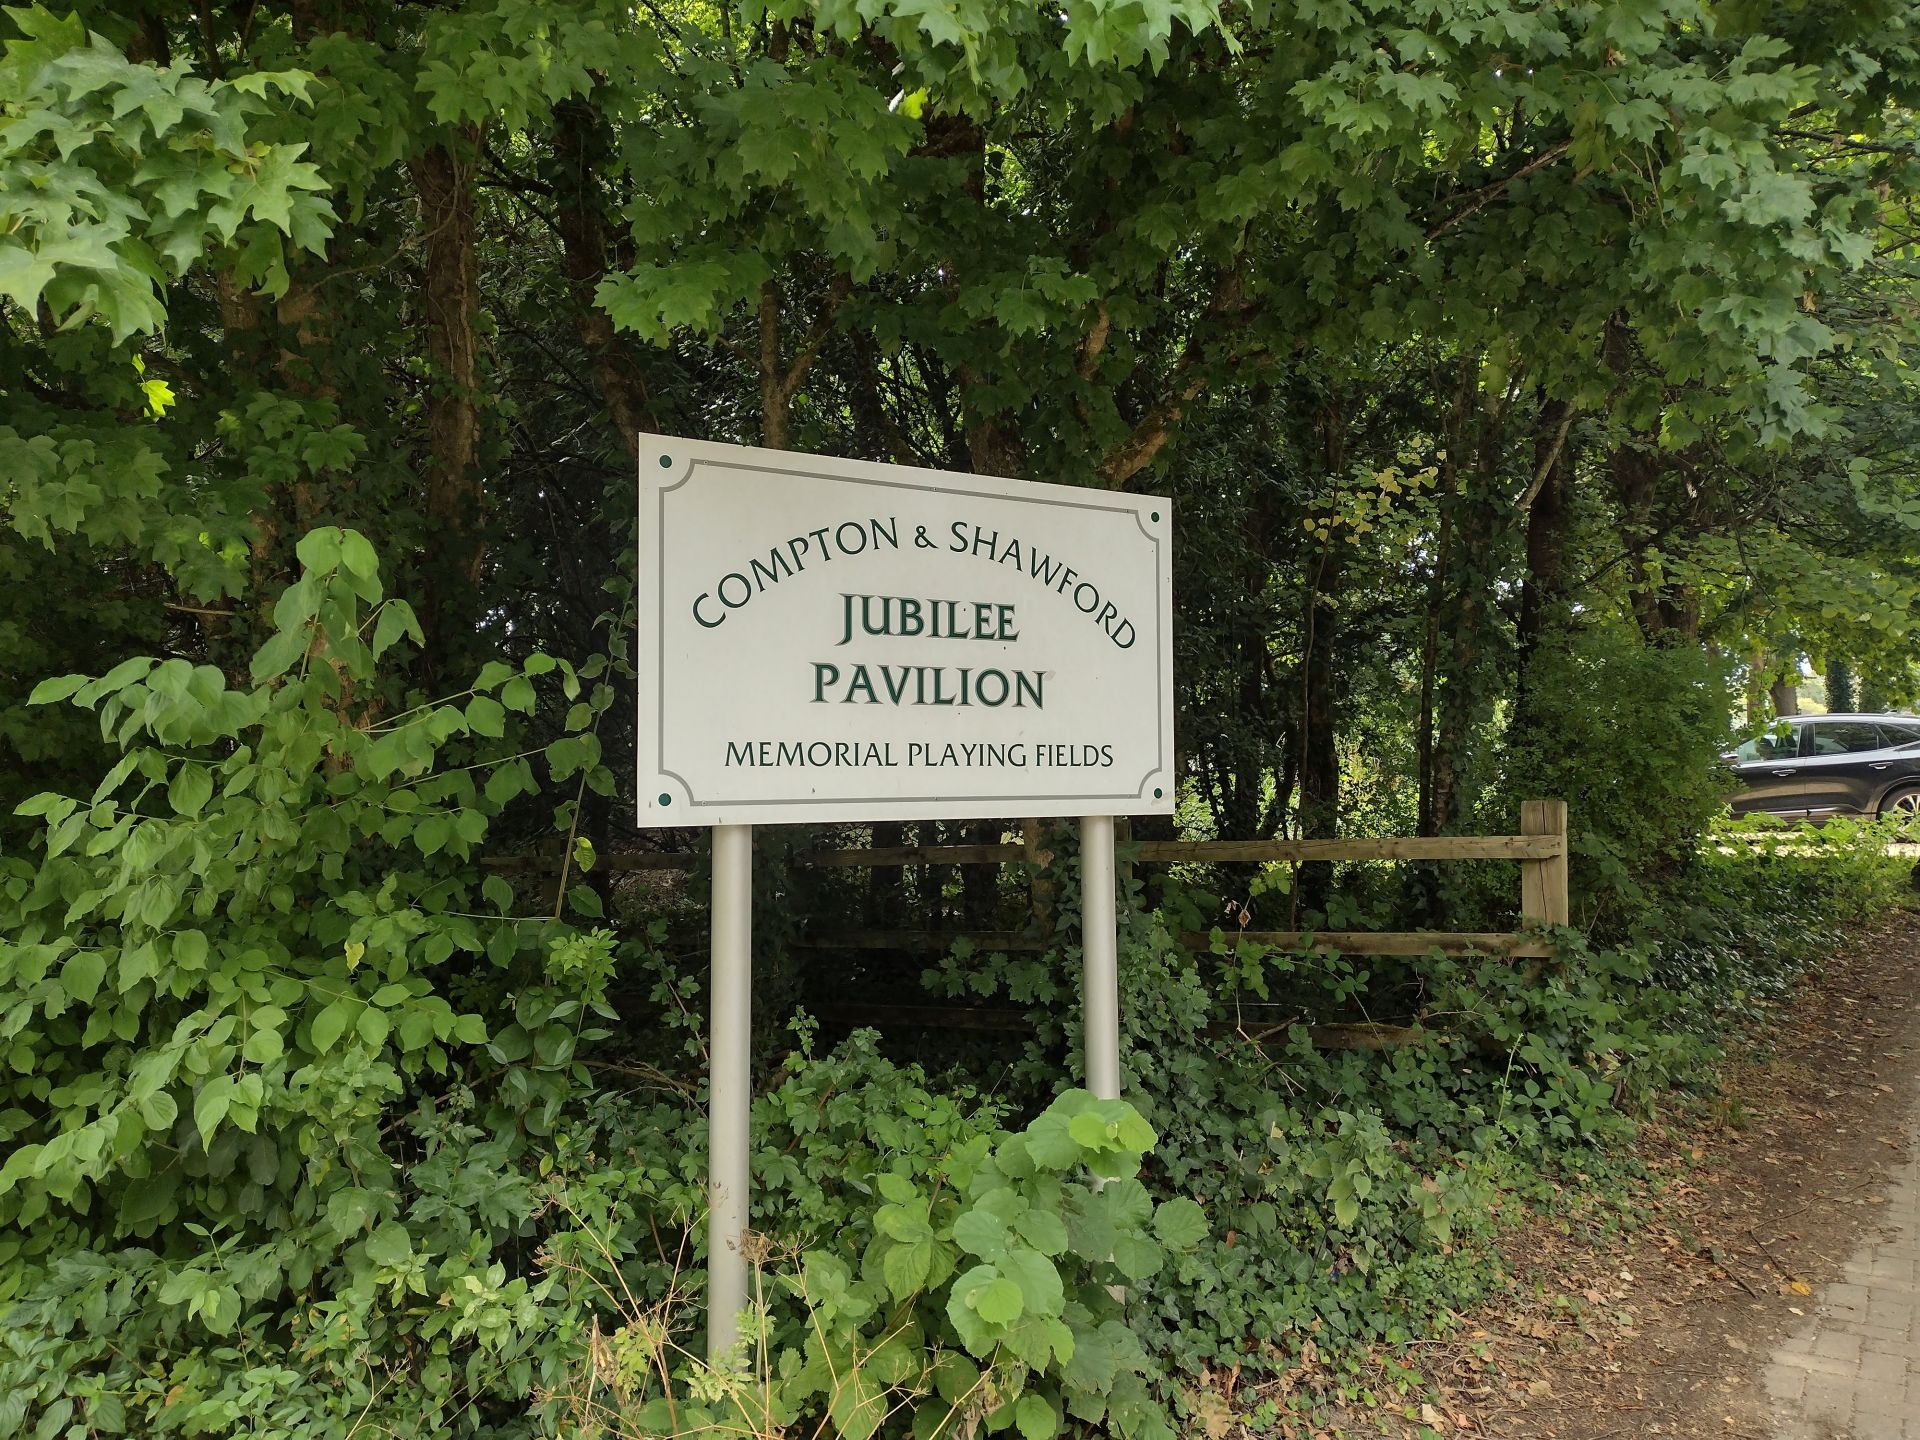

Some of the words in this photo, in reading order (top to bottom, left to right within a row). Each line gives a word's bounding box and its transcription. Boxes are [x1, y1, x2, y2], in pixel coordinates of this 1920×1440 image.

[693, 516, 899, 629] COMPTON
[914, 525, 938, 549] &
[949, 521, 1137, 649] SHAWFORD
[837, 594, 1019, 646] JUBILEE
[811, 662, 1046, 710] PAVILION
[725, 741, 899, 767] MEMORIAL
[908, 742, 1027, 767] PLAYING
[1036, 744, 1114, 768] FIELDS
